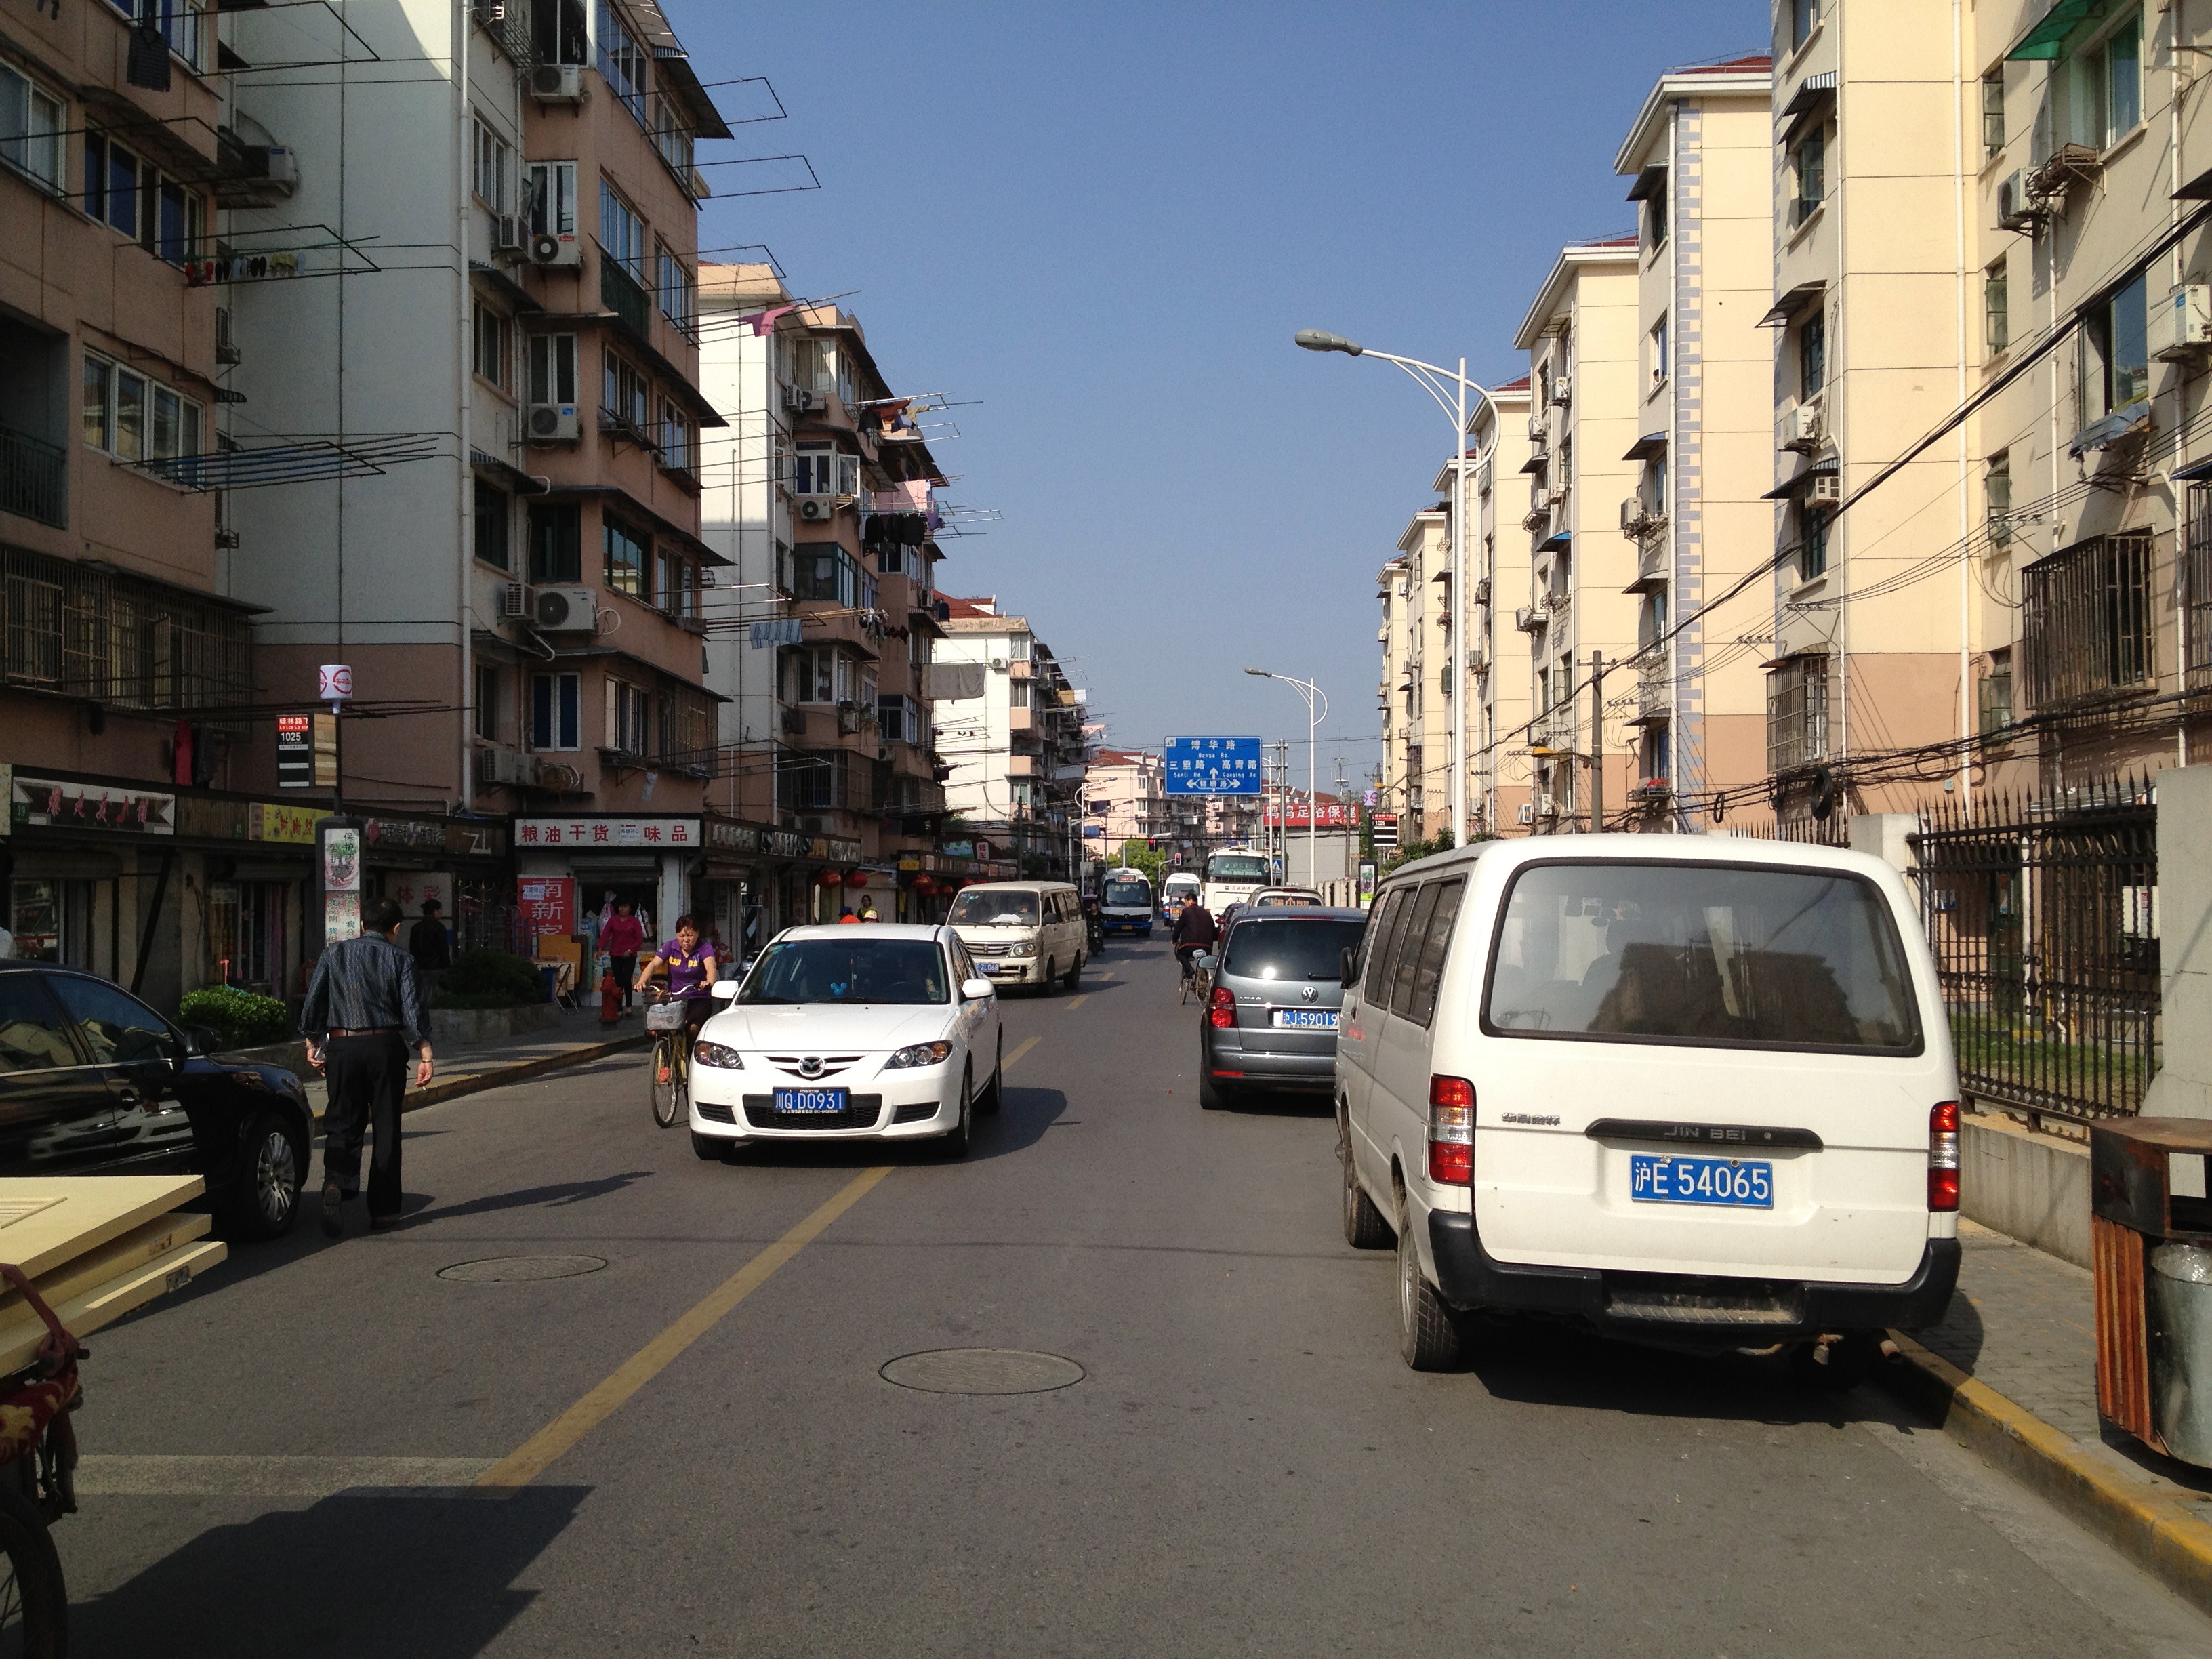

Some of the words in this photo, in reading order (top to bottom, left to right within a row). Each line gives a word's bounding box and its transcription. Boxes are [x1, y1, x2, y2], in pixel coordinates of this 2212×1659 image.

[281, 732, 302, 741] 1025
[1191, 739, 1235, 750] 博华路
[1169, 760, 1205, 770] 三里路
[1222, 760, 1258, 770] 高青路
[523, 825, 688, 843] 粮油干货味品
[1664, 1126, 1699, 1138] JIN
[1710, 1128, 1746, 1141] BEI
[1677, 1164, 1769, 1199] 54065
